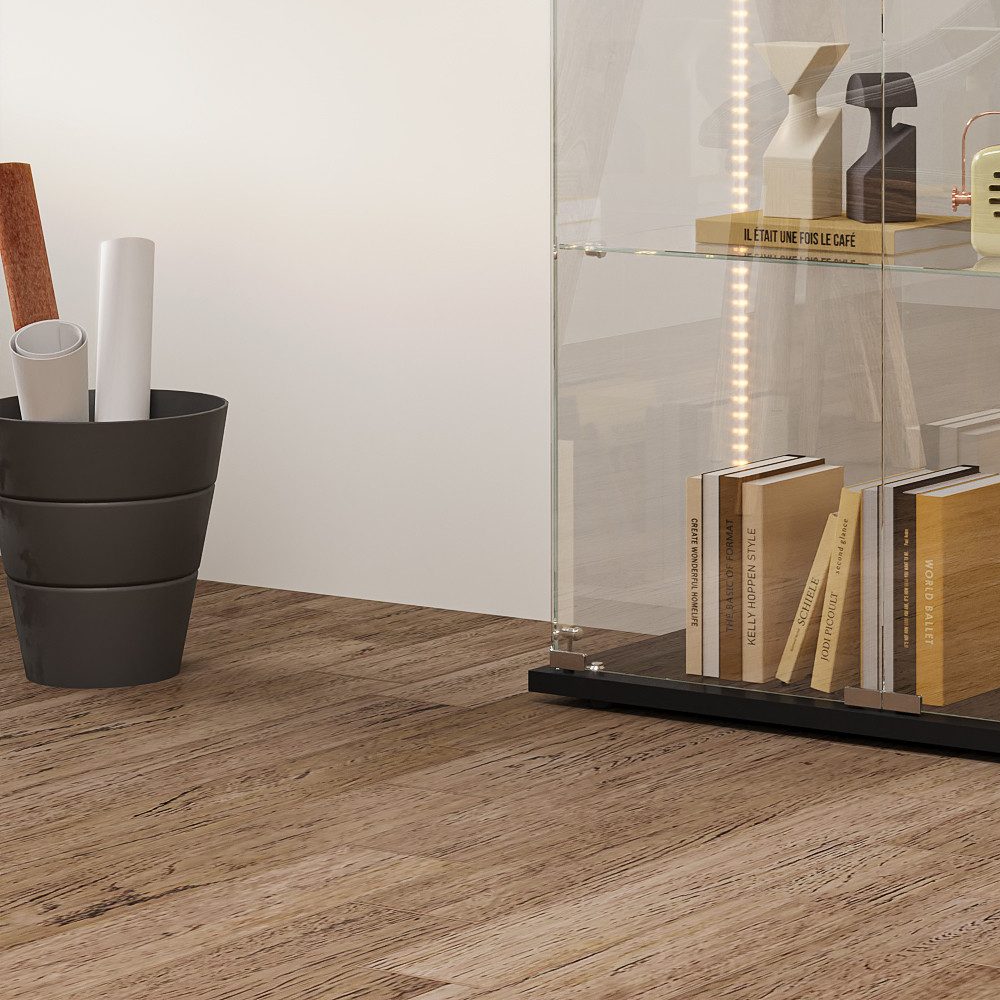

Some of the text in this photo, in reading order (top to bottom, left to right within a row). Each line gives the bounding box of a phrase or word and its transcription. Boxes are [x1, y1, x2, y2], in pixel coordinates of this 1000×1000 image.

[743, 226, 856, 248] IL ÉTAIT UNE FOIS LE CAFÉ
[690, 517, 699, 628] CREATE WONDERFUL HOMELIFE
[725, 519, 734, 633] THE BASIC OF FORMAT
[747, 528, 756, 646] KELLY HOPPEN STYLE
[798, 576, 820, 627] SCHIELE
[820, 518, 849, 662] JODI PICOULT second glance
[924, 559, 934, 646] WORLD BALLET
